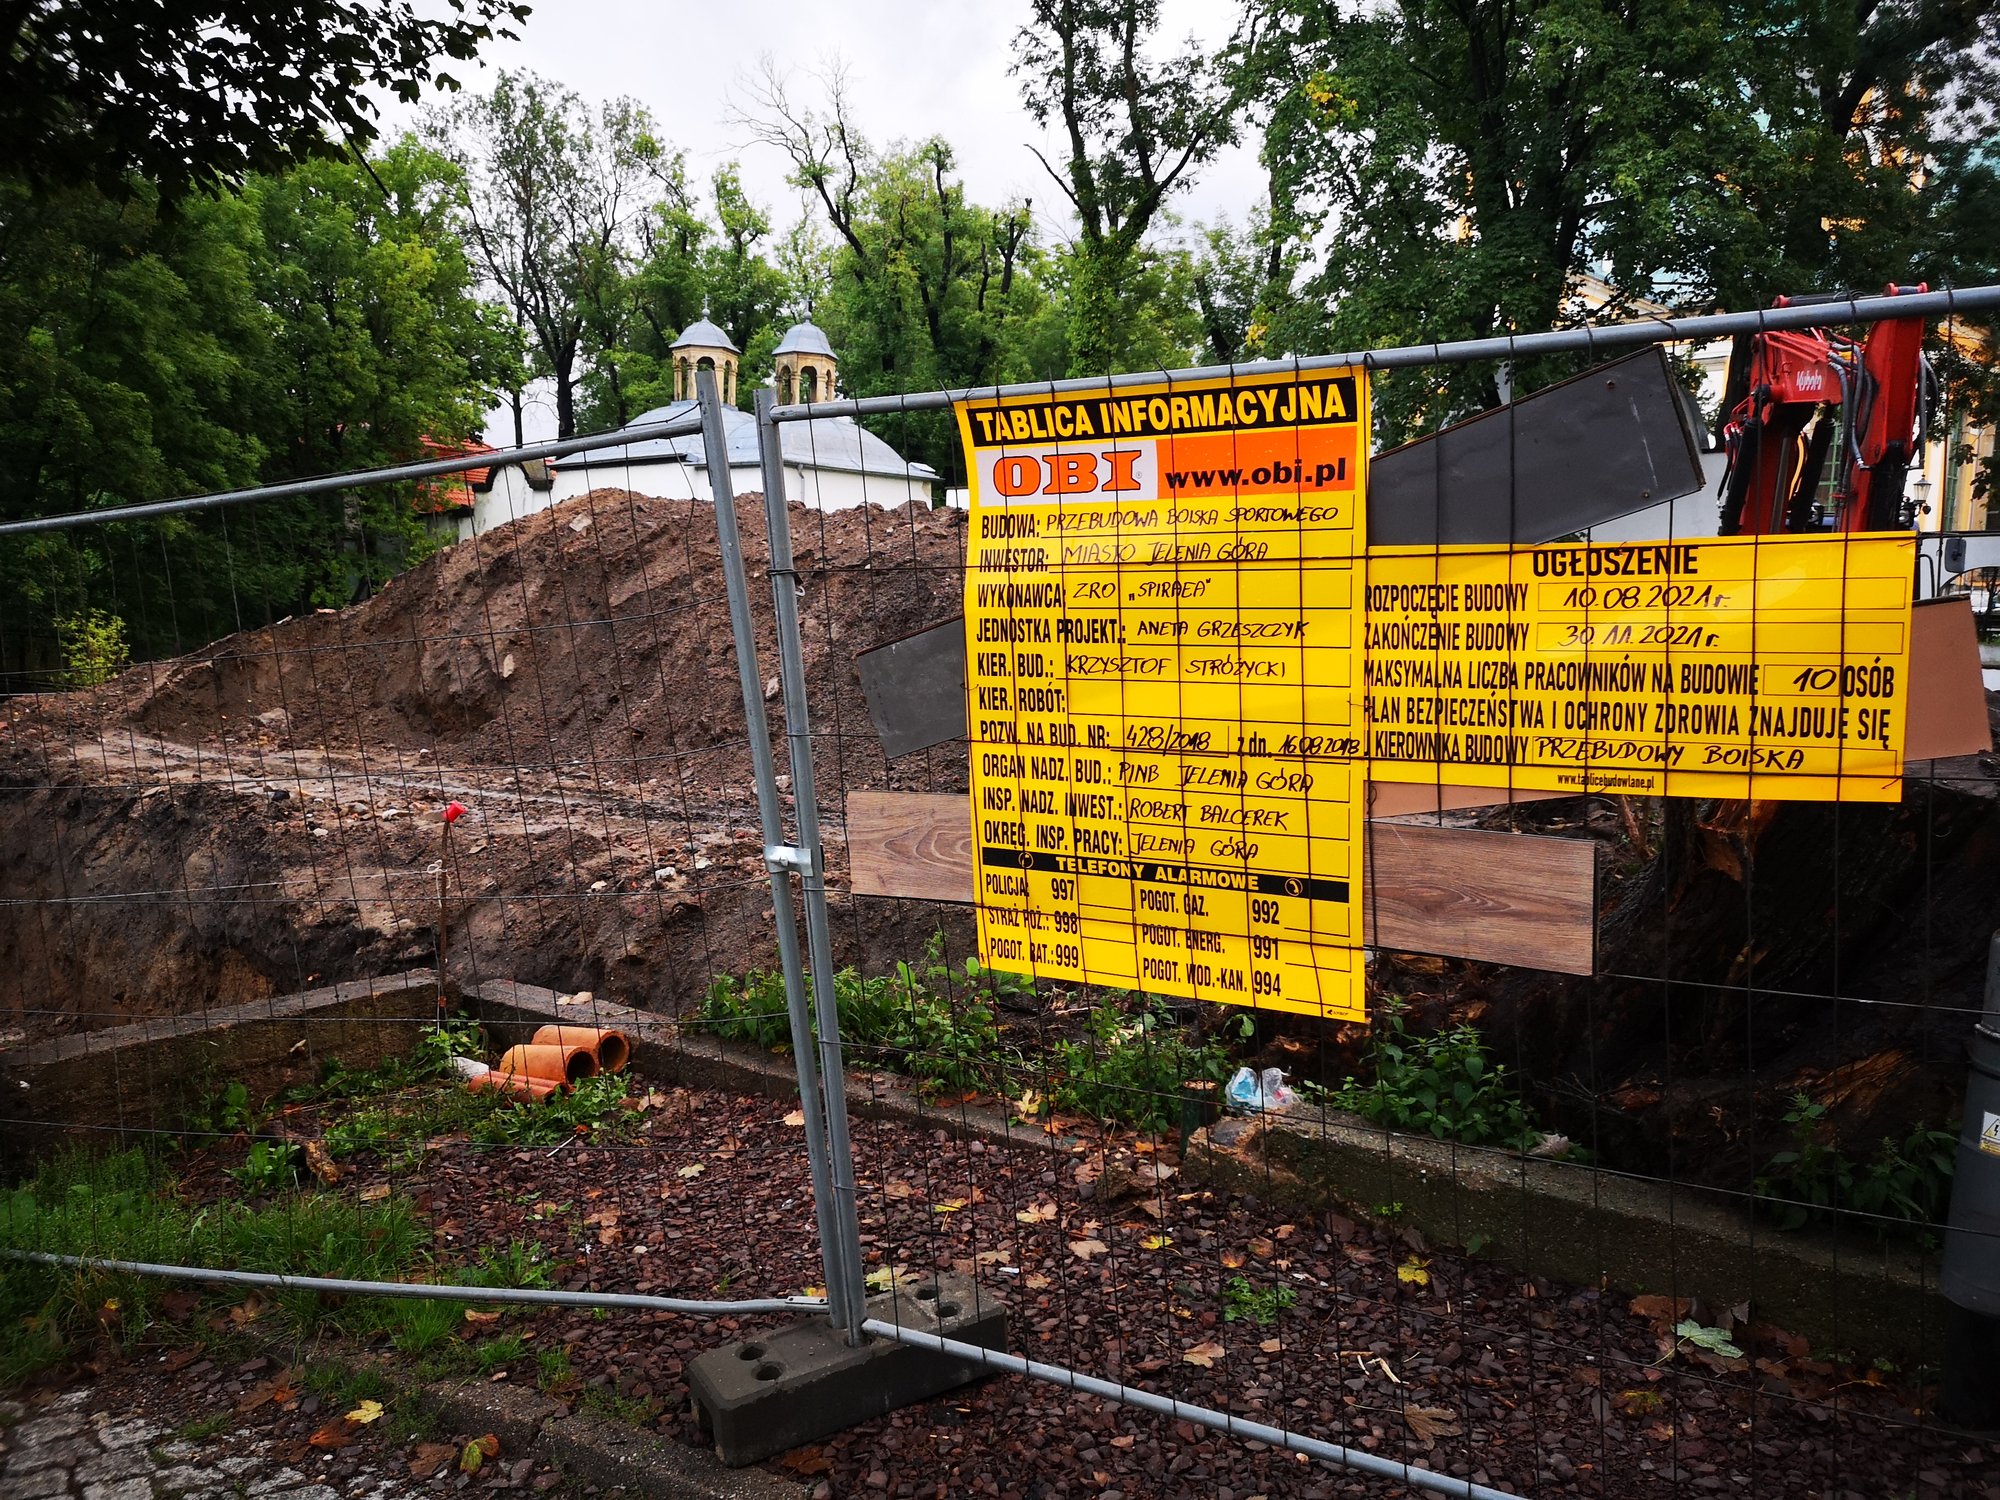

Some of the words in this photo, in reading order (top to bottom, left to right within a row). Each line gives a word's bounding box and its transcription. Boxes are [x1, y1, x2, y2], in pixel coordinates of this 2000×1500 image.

[976, 405, 1094, 441] TABLICA
[1099, 383, 1346, 434] INFORMACYJNA
[993, 450, 1142, 497] OBI
[1165, 457, 1346, 489] www.obi.pl
[981, 514, 1040, 539] BUDOWA:
[1046, 509, 1158, 531] PRZEBUDOWA
[1166, 508, 1219, 526] BOISKA
[1224, 506, 1338, 523] SPORTOWEGO
[979, 548, 1049, 573] INWESTOR:
[1063, 543, 1136, 564] MIASTO
[1147, 541, 1211, 566] JELENIA
[1217, 536, 1268, 560] GÓRA
[1532, 545, 1699, 577] OGŁOSZENIE
[978, 583, 1066, 608] WYKONAWCA:
[1073, 581, 1116, 599] ZRO
[1364, 584, 1459, 620] ROZPOCZĘCIE
[1465, 583, 1528, 612] BUDOWY
[977, 618, 1051, 643] JEDNOSTKA
[1137, 620, 1188, 637] ANETA
[1197, 620, 1310, 639] GRZESZCZYK
[1364, 614, 1460, 650] ZAKOŃCZENIE
[1466, 623, 1529, 651] BUDOWY
[977, 652, 1011, 677] KIER.
[1018, 653, 1053, 678] BUD.:
[1067, 654, 1171, 676] KRZYSZTOF
[1364, 659, 1462, 689] MAKSYMALNA
[1468, 661, 1518, 690] LICZBA
[1525, 653, 1647, 693] PRACOWNIKÓW
[1652, 663, 1674, 693] NA
[1681, 663, 1759, 695] BUDOWIE
[1793, 667, 1837, 692] 10
[1843, 656, 1894, 698] OSÓB
[979, 687, 1012, 711] KIER.
[1019, 681, 1065, 713] ROBÓT:
[980, 720, 1020, 743] POZW.
[1027, 722, 1044, 744] NA
[1050, 722, 1081, 747] BUD.
[1088, 724, 1110, 749] NR:
[1126, 724, 1211, 756] 428/2018
[1407, 690, 1545, 729] BEZPIECZEŃSTWA
[1552, 701, 1557, 729] I
[1564, 701, 1648, 733] OCHRONY
[1654, 703, 1740, 736] ZDROWIA
[1749, 706, 1848, 740] ZNAJDUJE
[1858, 708, 1891, 750] SIĘ
[1375, 731, 1460, 761] KIEROWNIKA
[1466, 733, 1529, 764] BUDOWY
[1534, 736, 1685, 766] PRZEBUDOWY
[1702, 745, 1804, 770] BOISKA
[983, 753, 1025, 778] ORGAN
[1031, 756, 1068, 781] NADZ.
[1076, 759, 1111, 785] BUD.:
[1118, 761, 1159, 783] PINB
[1175, 764, 1247, 788] JELENIA
[1256, 768, 1313, 793] GÓRA
[1557, 773, 1655, 792] www.tablicebudowlane.pl
[983, 787, 1015, 811] INSP.
[1021, 788, 1058, 815] NADZ.
[1065, 792, 1122, 820] INWEST.:
[1129, 798, 1192, 821] ROBERT
[1200, 805, 1289, 831] BALCEREK
[984, 820, 1029, 850] OKRĘG.
[1036, 824, 1067, 850] INSP.
[1075, 828, 1122, 855] PRACY:
[1131, 832, 1195, 855] JELENIA
[1211, 837, 1258, 860] GÓRA
[1056, 857, 1144, 878] TELEFONY
[1155, 867, 1259, 890] ALARMOWE
[986, 874, 1029, 897] POLICJA:
[1051, 878, 1075, 901] 997
[1140, 889, 1179, 914] POGOT.
[1184, 894, 1209, 917] GAZ.
[1252, 899, 1280, 925] 992
[988, 903, 1020, 927] STRAŻ
[1054, 911, 1078, 935] 998
[1142, 923, 1181, 948] POGOT.
[1186, 929, 1226, 954] ENERG.
[1253, 935, 1279, 960] 991
[990, 937, 1025, 961] POGOT.
[1056, 944, 1078, 968] 999
[1143, 958, 1181, 983] POGOT.
[1186, 963, 1248, 992] WOD.-KAN.
[1254, 970, 1281, 997] 994
